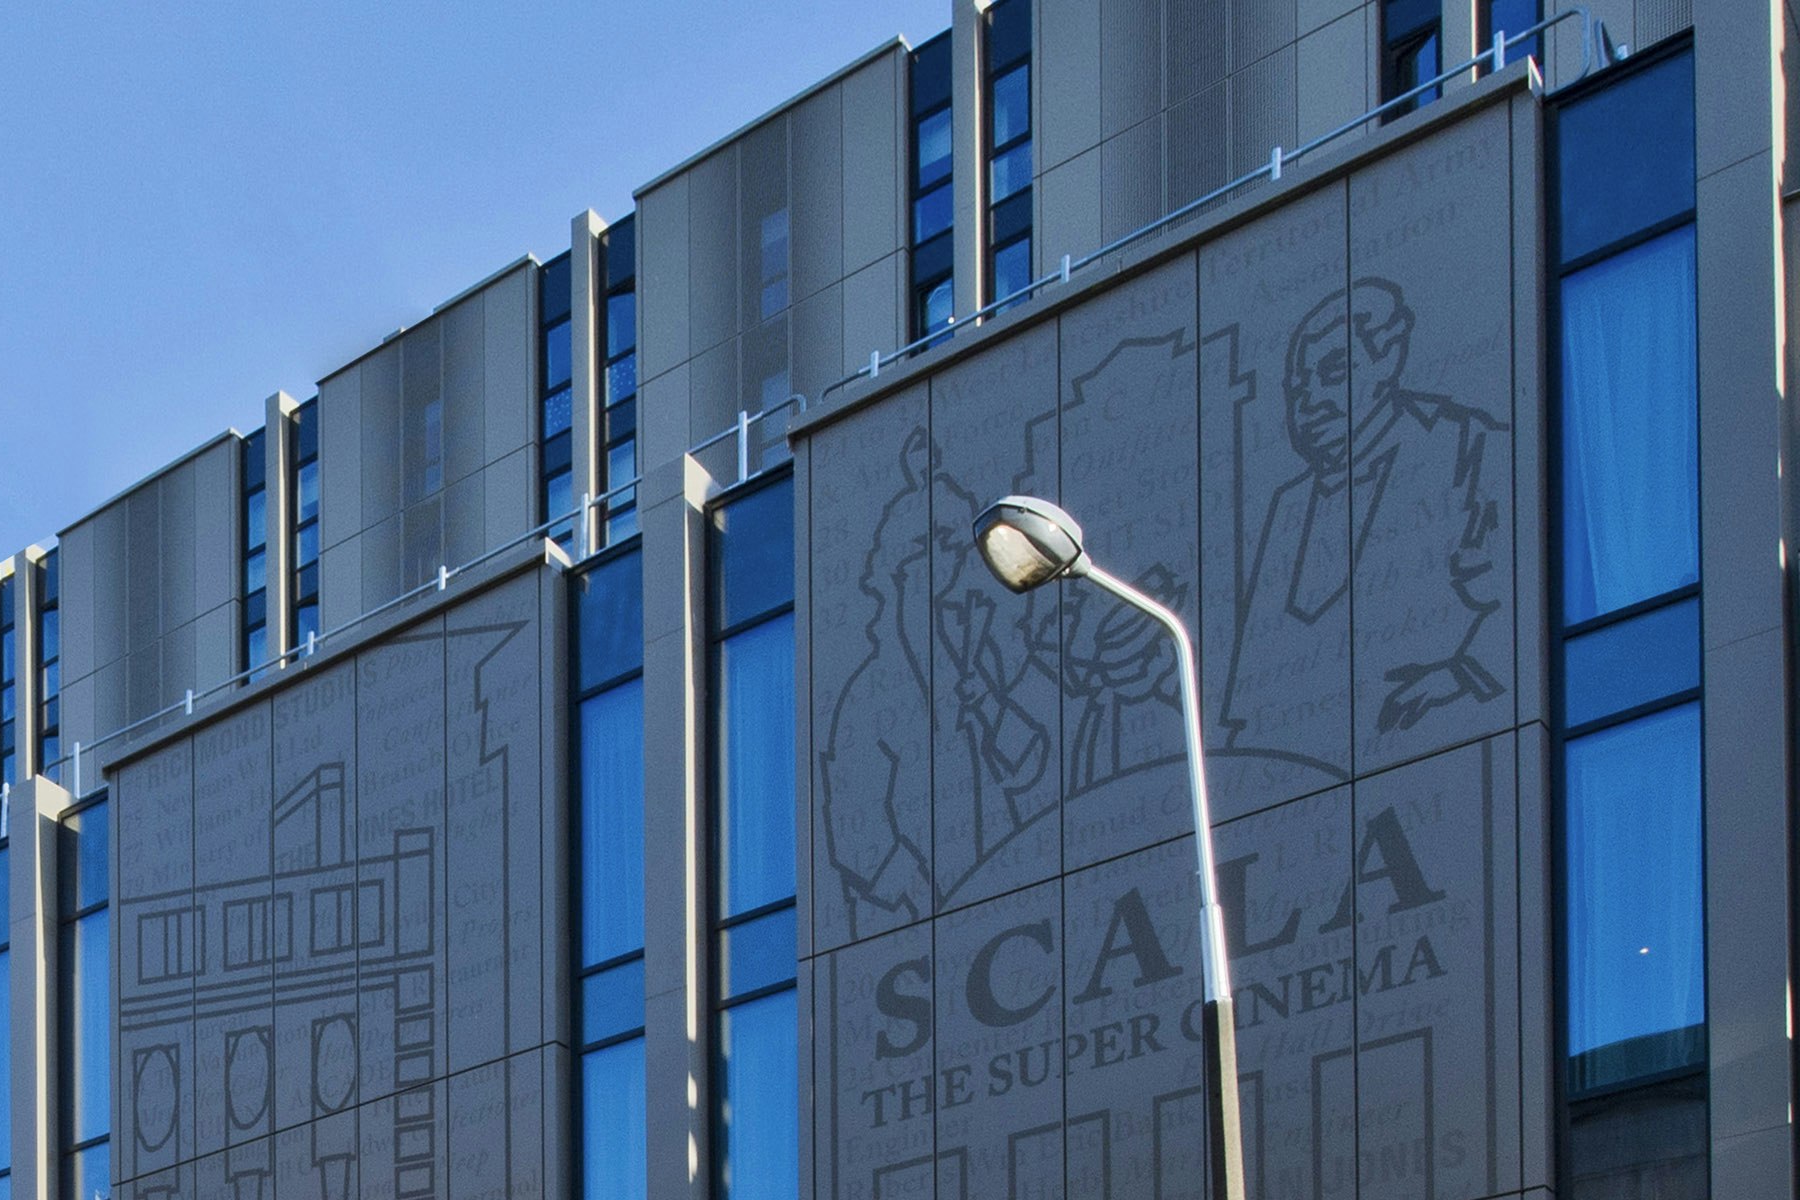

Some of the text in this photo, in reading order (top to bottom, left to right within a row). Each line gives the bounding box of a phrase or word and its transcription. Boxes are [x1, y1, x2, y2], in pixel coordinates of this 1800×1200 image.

[875, 805, 1448, 1061] SCALA
[859, 1063, 975, 1130] THE
[987, 1012, 1168, 1098] SUPER
